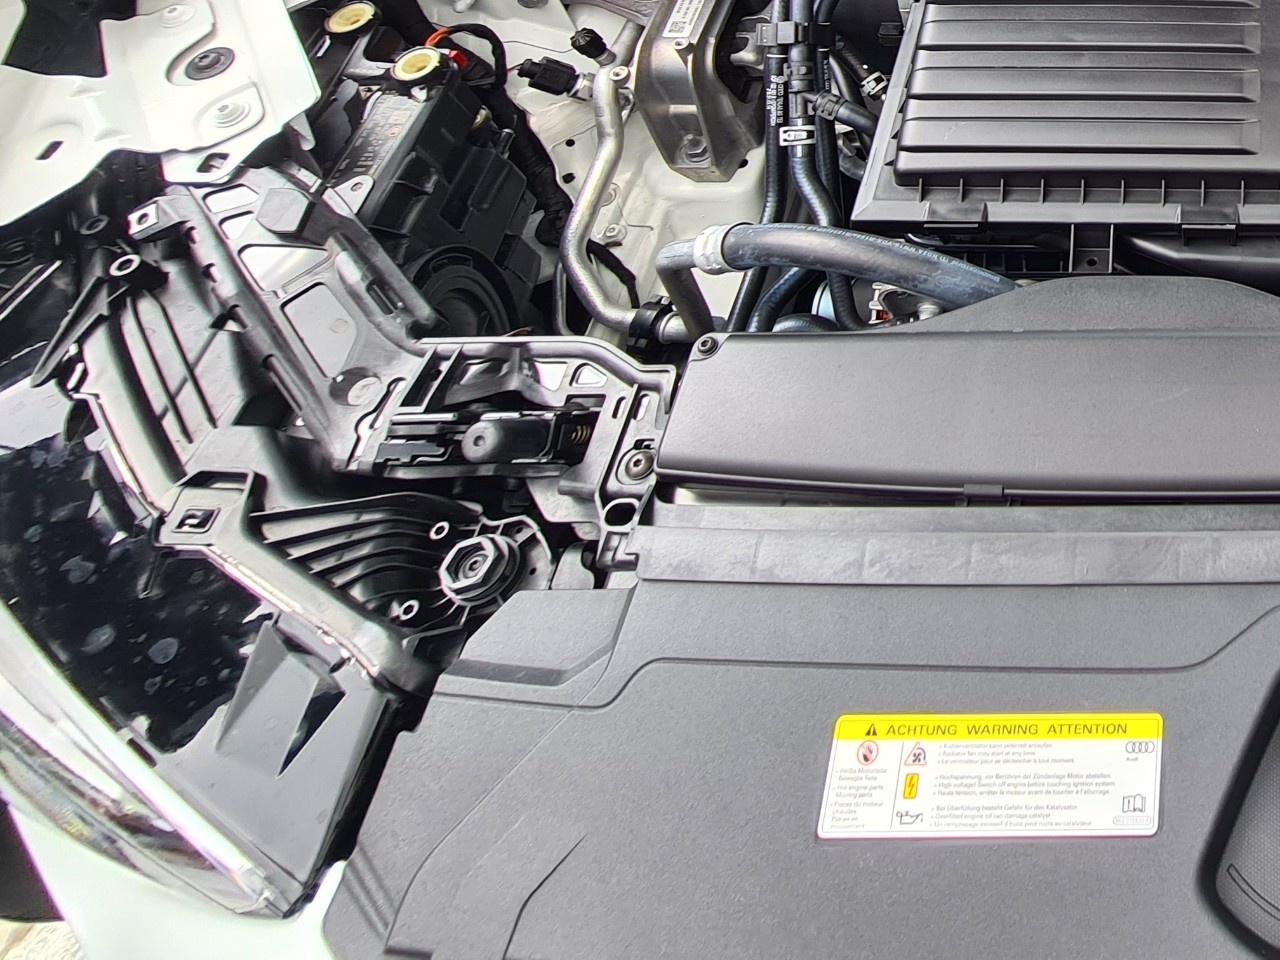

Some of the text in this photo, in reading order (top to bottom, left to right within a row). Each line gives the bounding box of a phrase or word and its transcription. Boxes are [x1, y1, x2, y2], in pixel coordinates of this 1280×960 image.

[886, 722, 1128, 736] ACHTUNG WARNING ATTENTION
